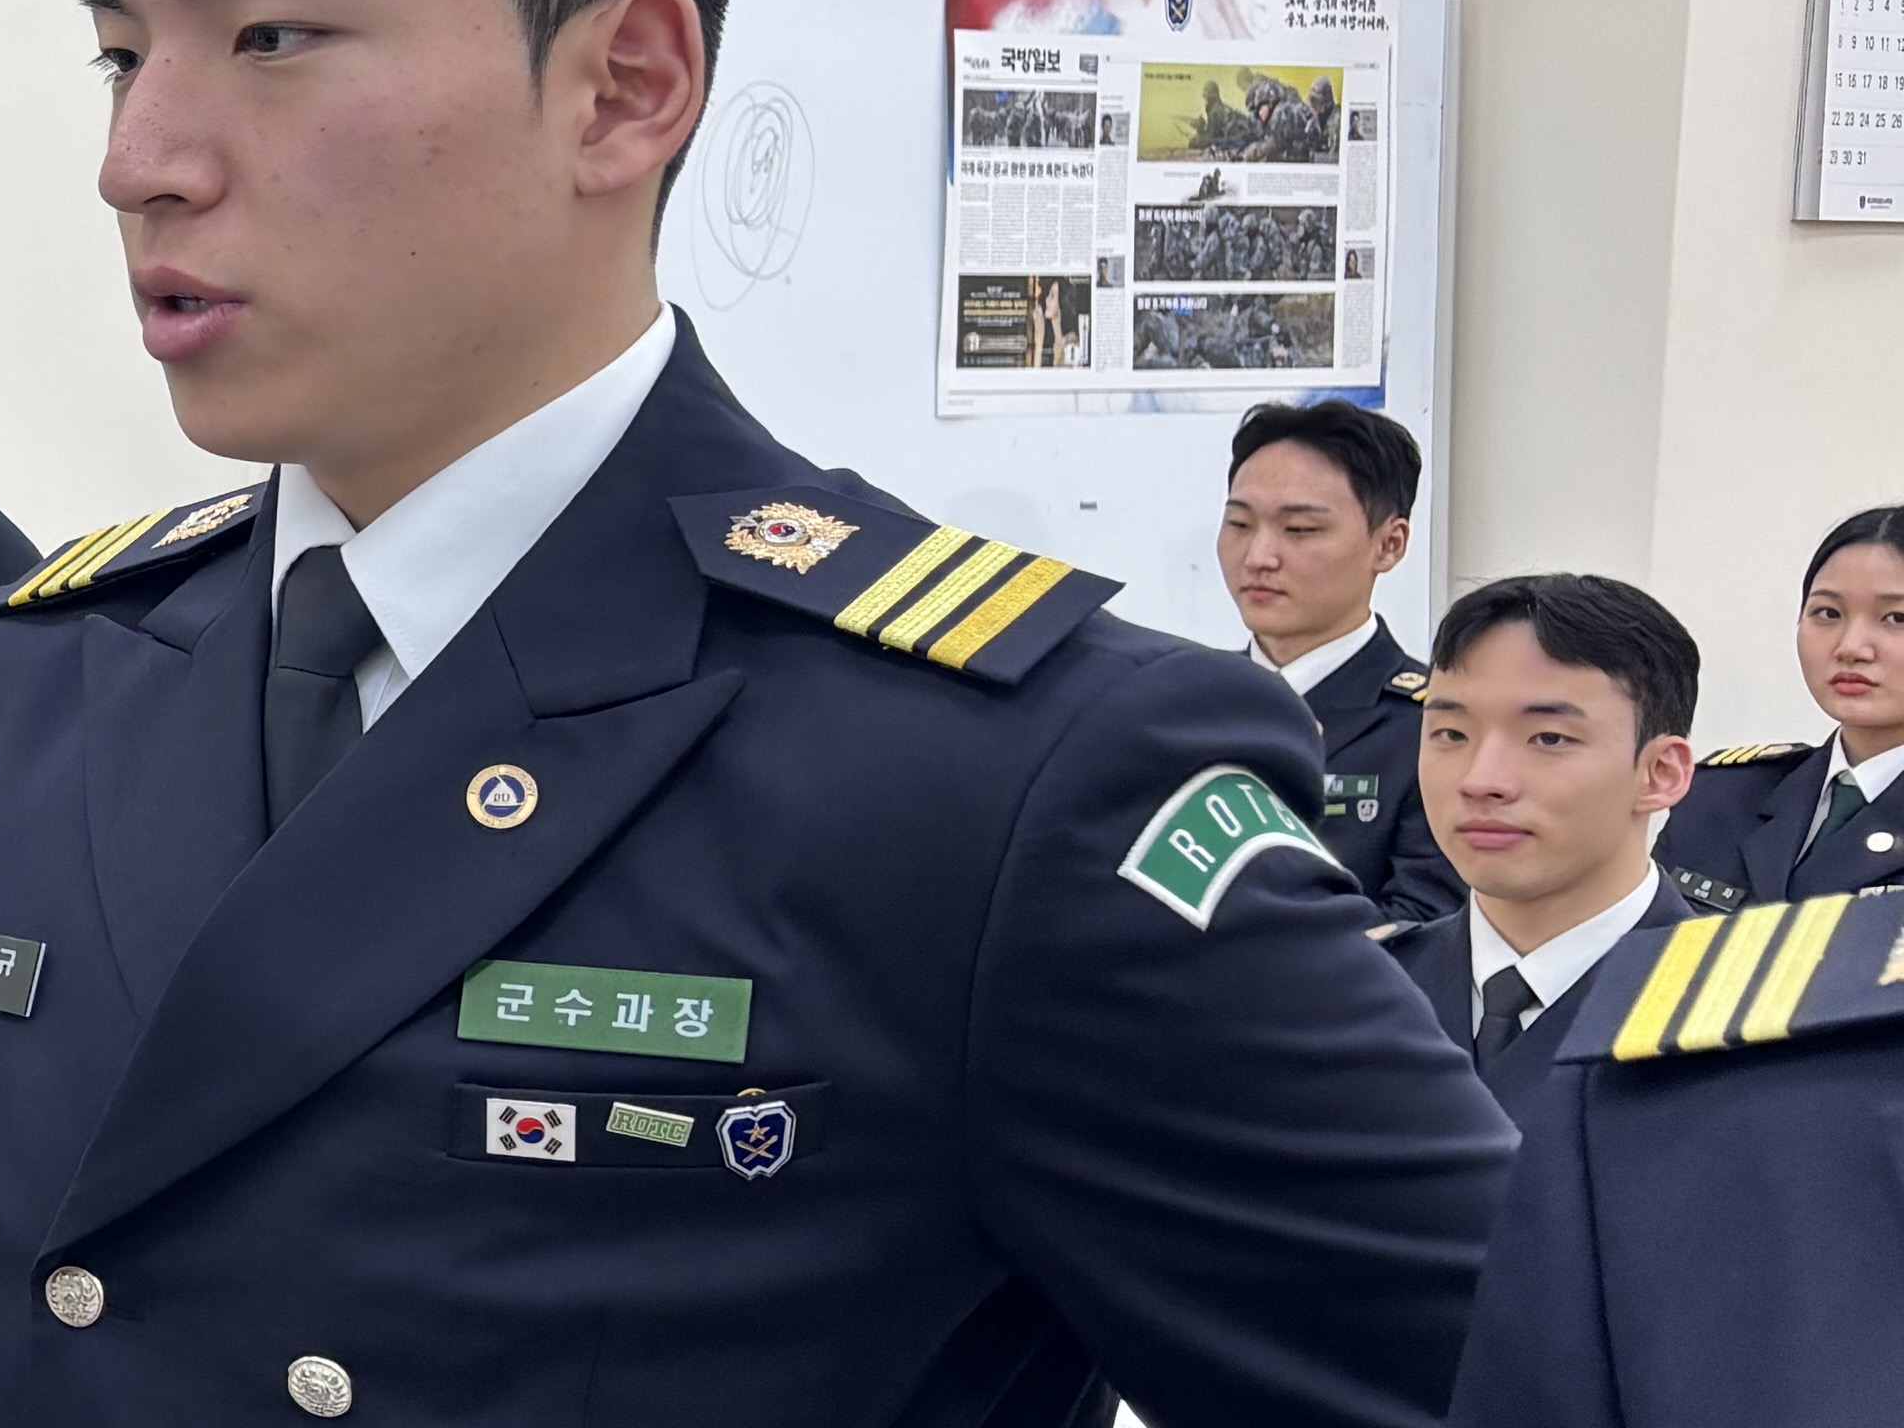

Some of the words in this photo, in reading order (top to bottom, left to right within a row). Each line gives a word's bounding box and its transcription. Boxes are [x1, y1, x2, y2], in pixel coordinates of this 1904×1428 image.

[1884, 0, 1890, 11] 4
[1852, 36, 1857, 49] 9
[1866, 36, 1874, 50] 10
[1881, 37, 1889, 51] 11
[1001, 48, 1060, 73] 국방일보
[1835, 72, 1843, 87] 15
[1848, 74, 1857, 87] 16
[1863, 74, 1873, 88] 17
[1879, 75, 1888, 90] 18
[1831, 111, 1840, 126] 22
[1845, 112, 1854, 126] 23
[1860, 113, 1869, 127] 24
[1875, 113, 1886, 128] 25
[1892, 114, 1903, 128] 26
[1843, 150, 1852, 165] 30
[1857, 151, 1867, 165] 31
[1167, 783, 1296, 873] ROTC
[496, 982, 715, 1039] 군수과장
[609, 1108, 689, 1144] ROTC
